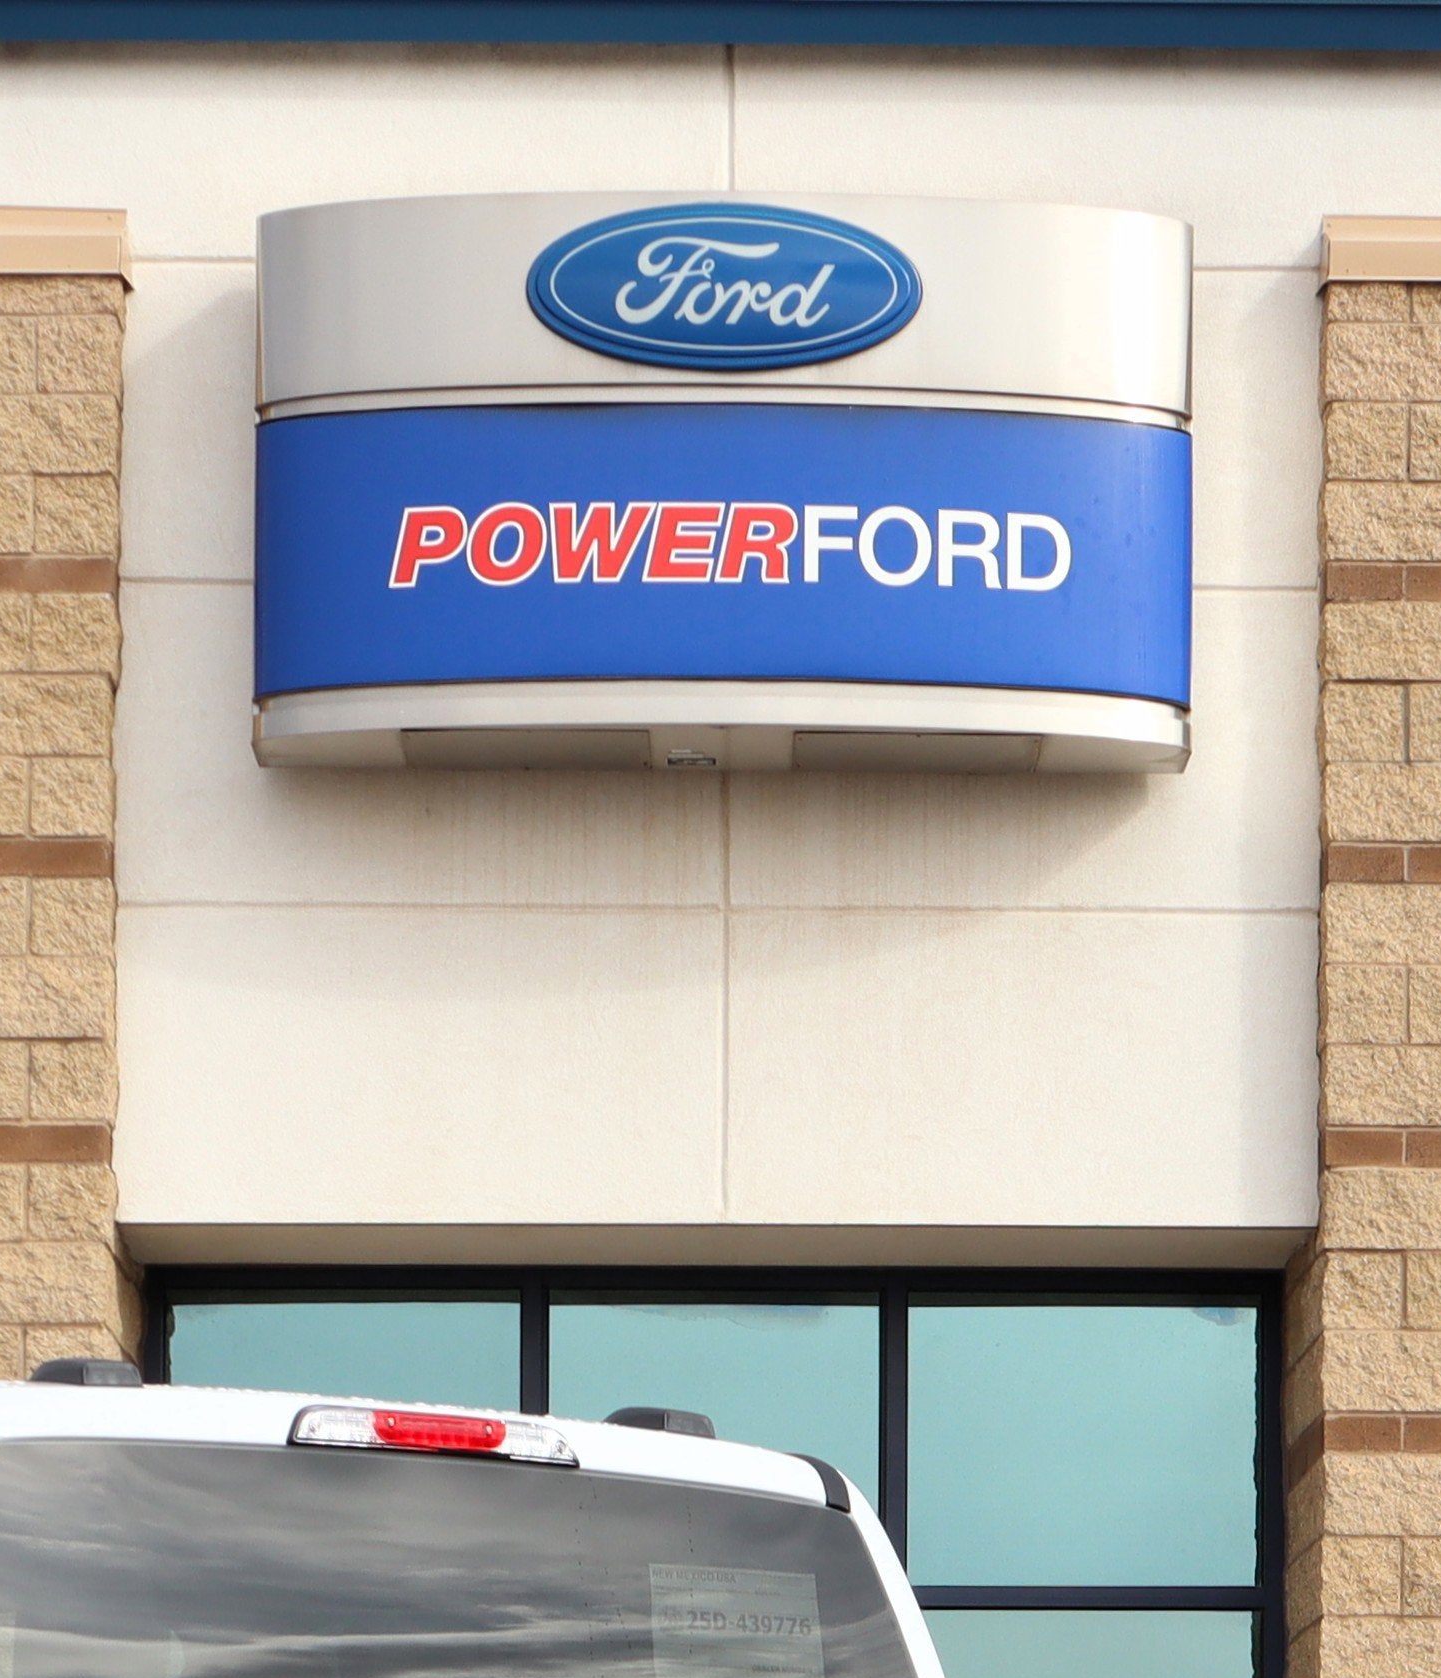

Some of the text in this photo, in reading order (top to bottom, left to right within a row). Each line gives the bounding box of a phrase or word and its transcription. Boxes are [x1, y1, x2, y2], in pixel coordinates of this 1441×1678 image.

[614, 234, 835, 331] Ford
[388, 499, 1072, 593] POWERFORD
[686, 1610, 812, 1636] 25D-439776
